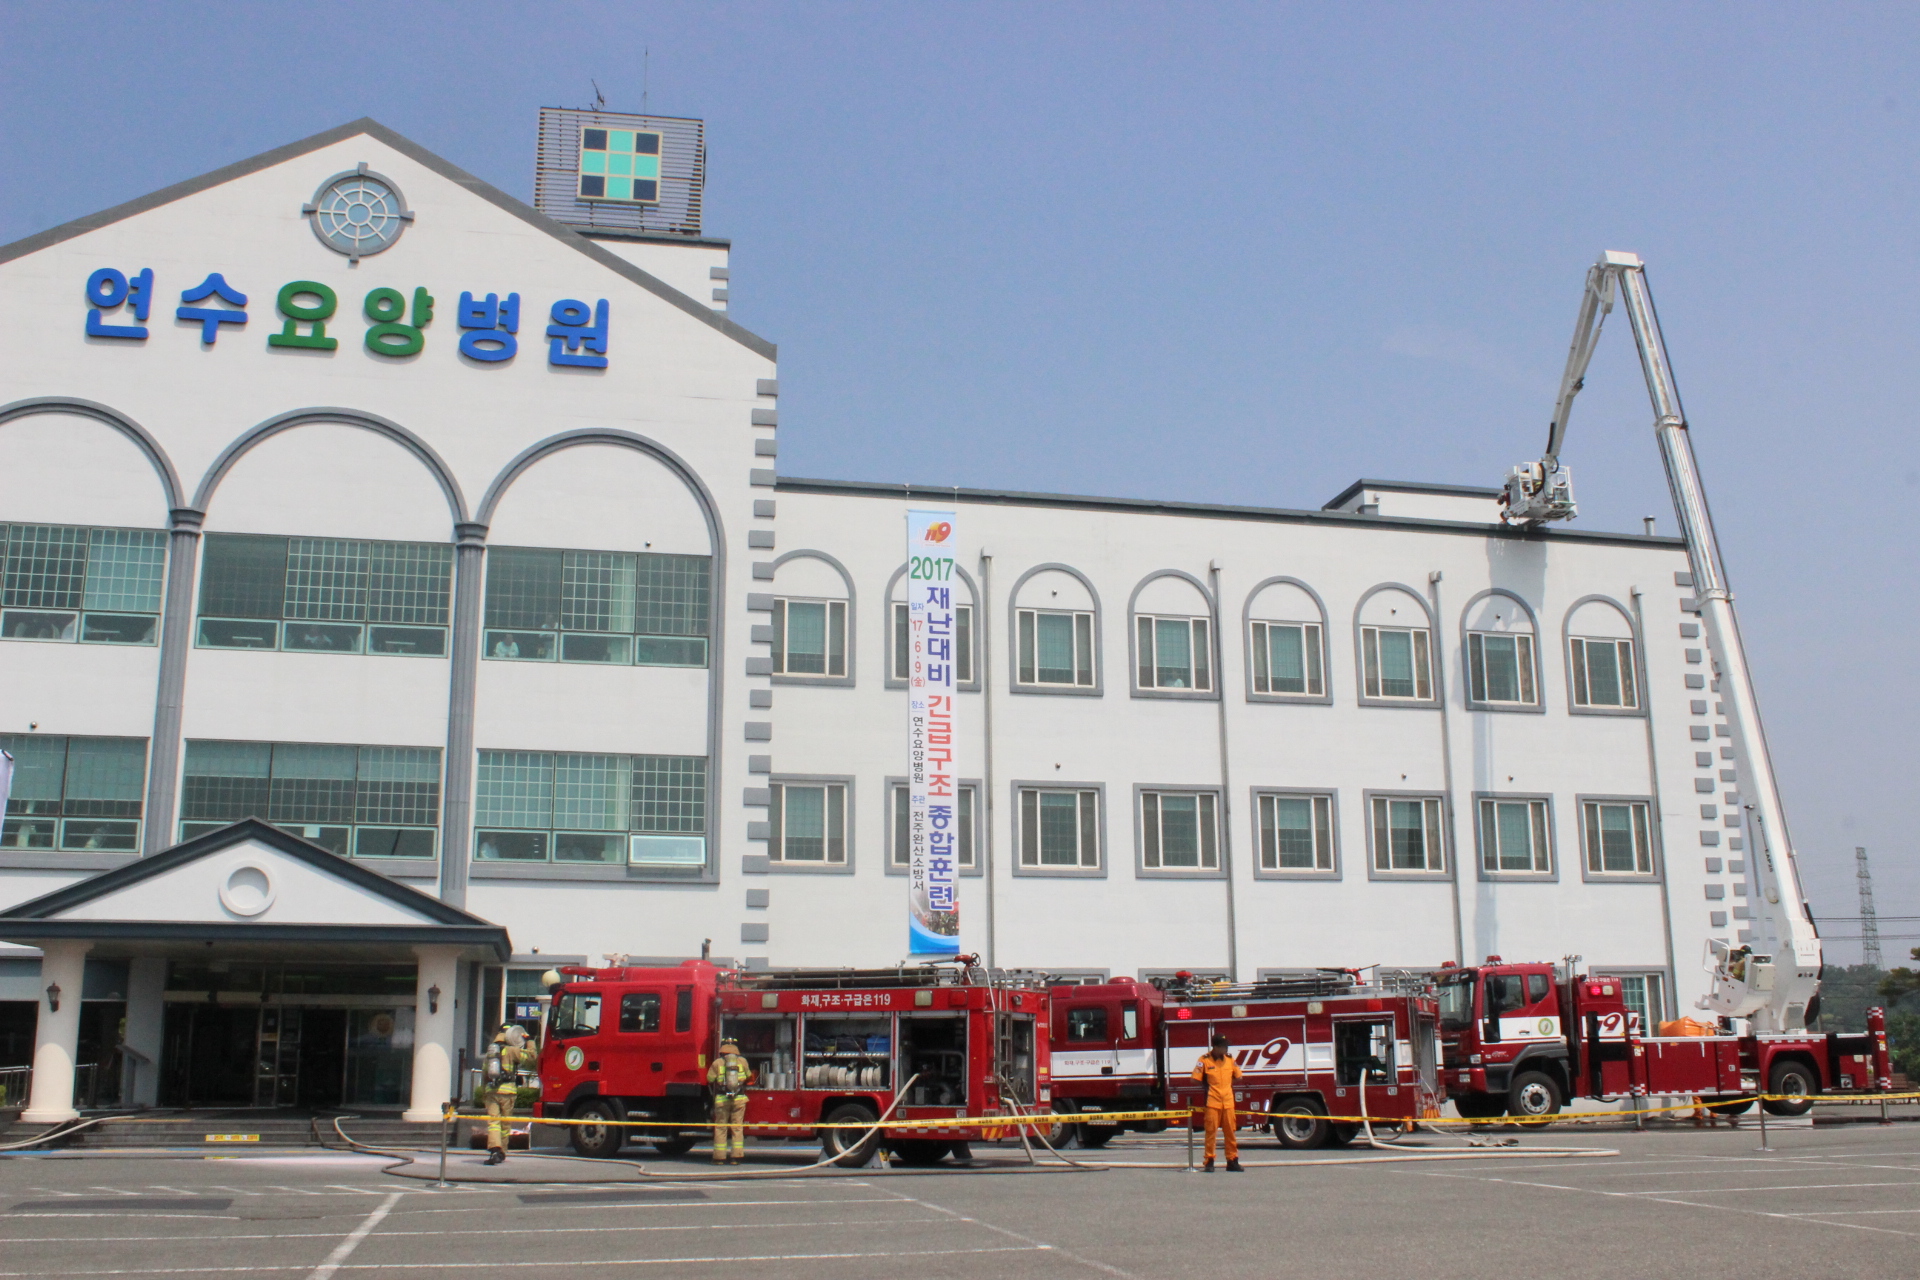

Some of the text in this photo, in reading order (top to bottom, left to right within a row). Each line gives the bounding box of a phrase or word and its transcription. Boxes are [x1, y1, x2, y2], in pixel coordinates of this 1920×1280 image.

[86, 267, 610, 369] 연수요양병원
[910, 556, 953, 581] 2017
[912, 716, 924, 784] 연수요양병원
[926, 587, 954, 910] 재난대비 긴급구조 종합훈련
[912, 811, 924, 892] 전주완산소방서
[1234, 1038, 1290, 1069] 119
